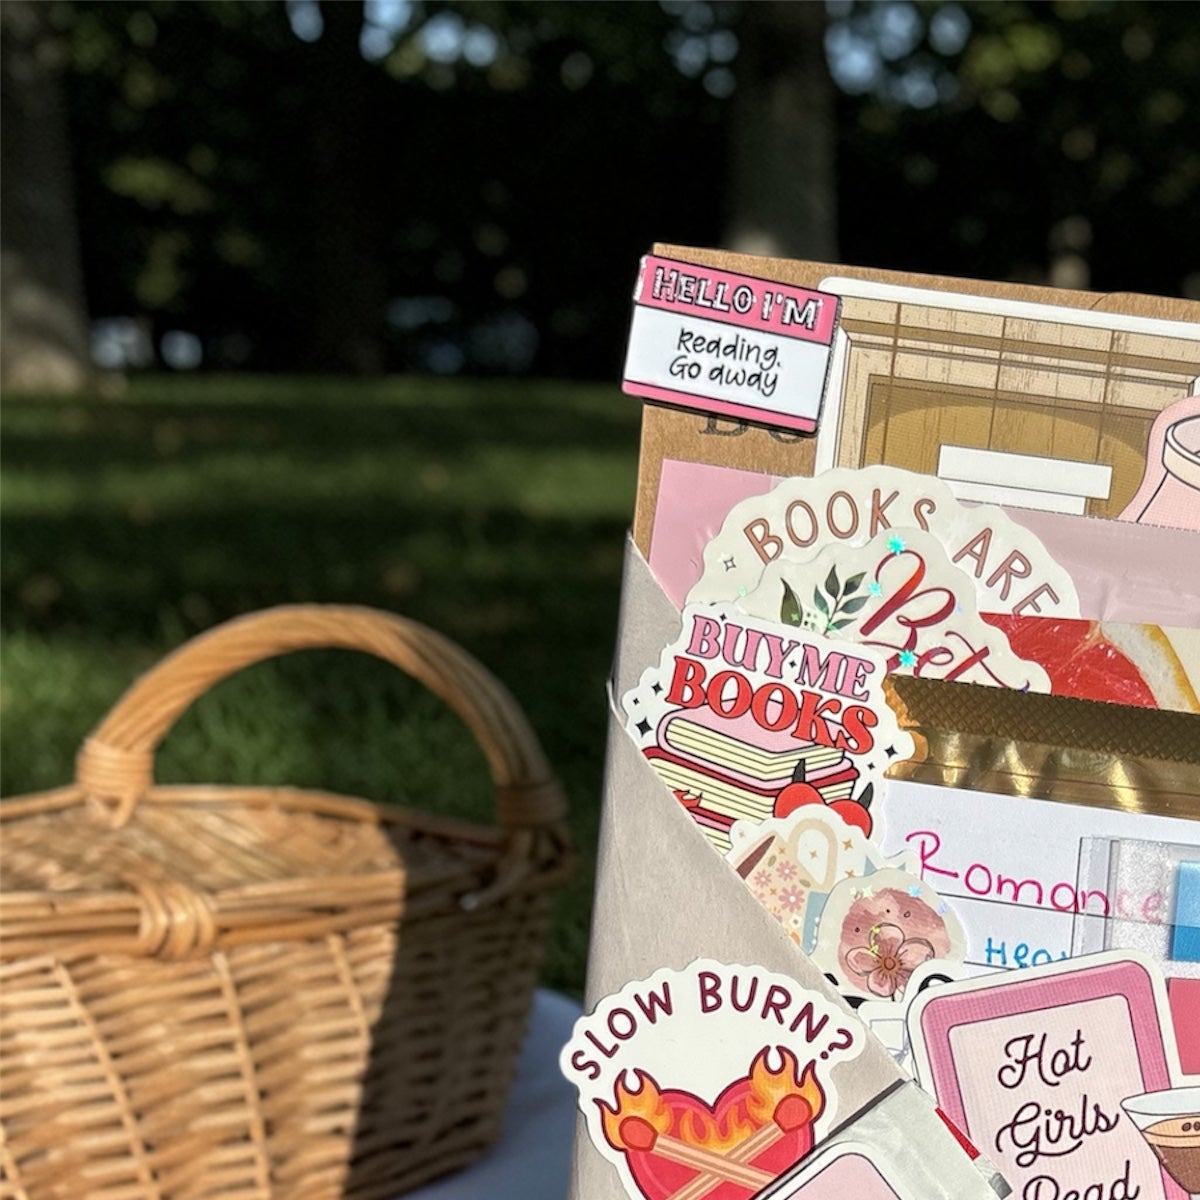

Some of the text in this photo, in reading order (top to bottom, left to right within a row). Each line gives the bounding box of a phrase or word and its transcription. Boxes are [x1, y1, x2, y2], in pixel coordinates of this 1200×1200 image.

[652, 266, 823, 331] HELLO I'M
[669, 354, 778, 398] Go away
[744, 488, 1060, 617] BOOKS ARE
[686, 614, 876, 702] BUY ME
[666, 656, 880, 756] BOOKS
[905, 831, 1163, 924] Romance
[571, 971, 854, 1080] SLOW BURN?
[997, 1028, 1092, 1089] Hot
[995, 1094, 1120, 1168] Girls
